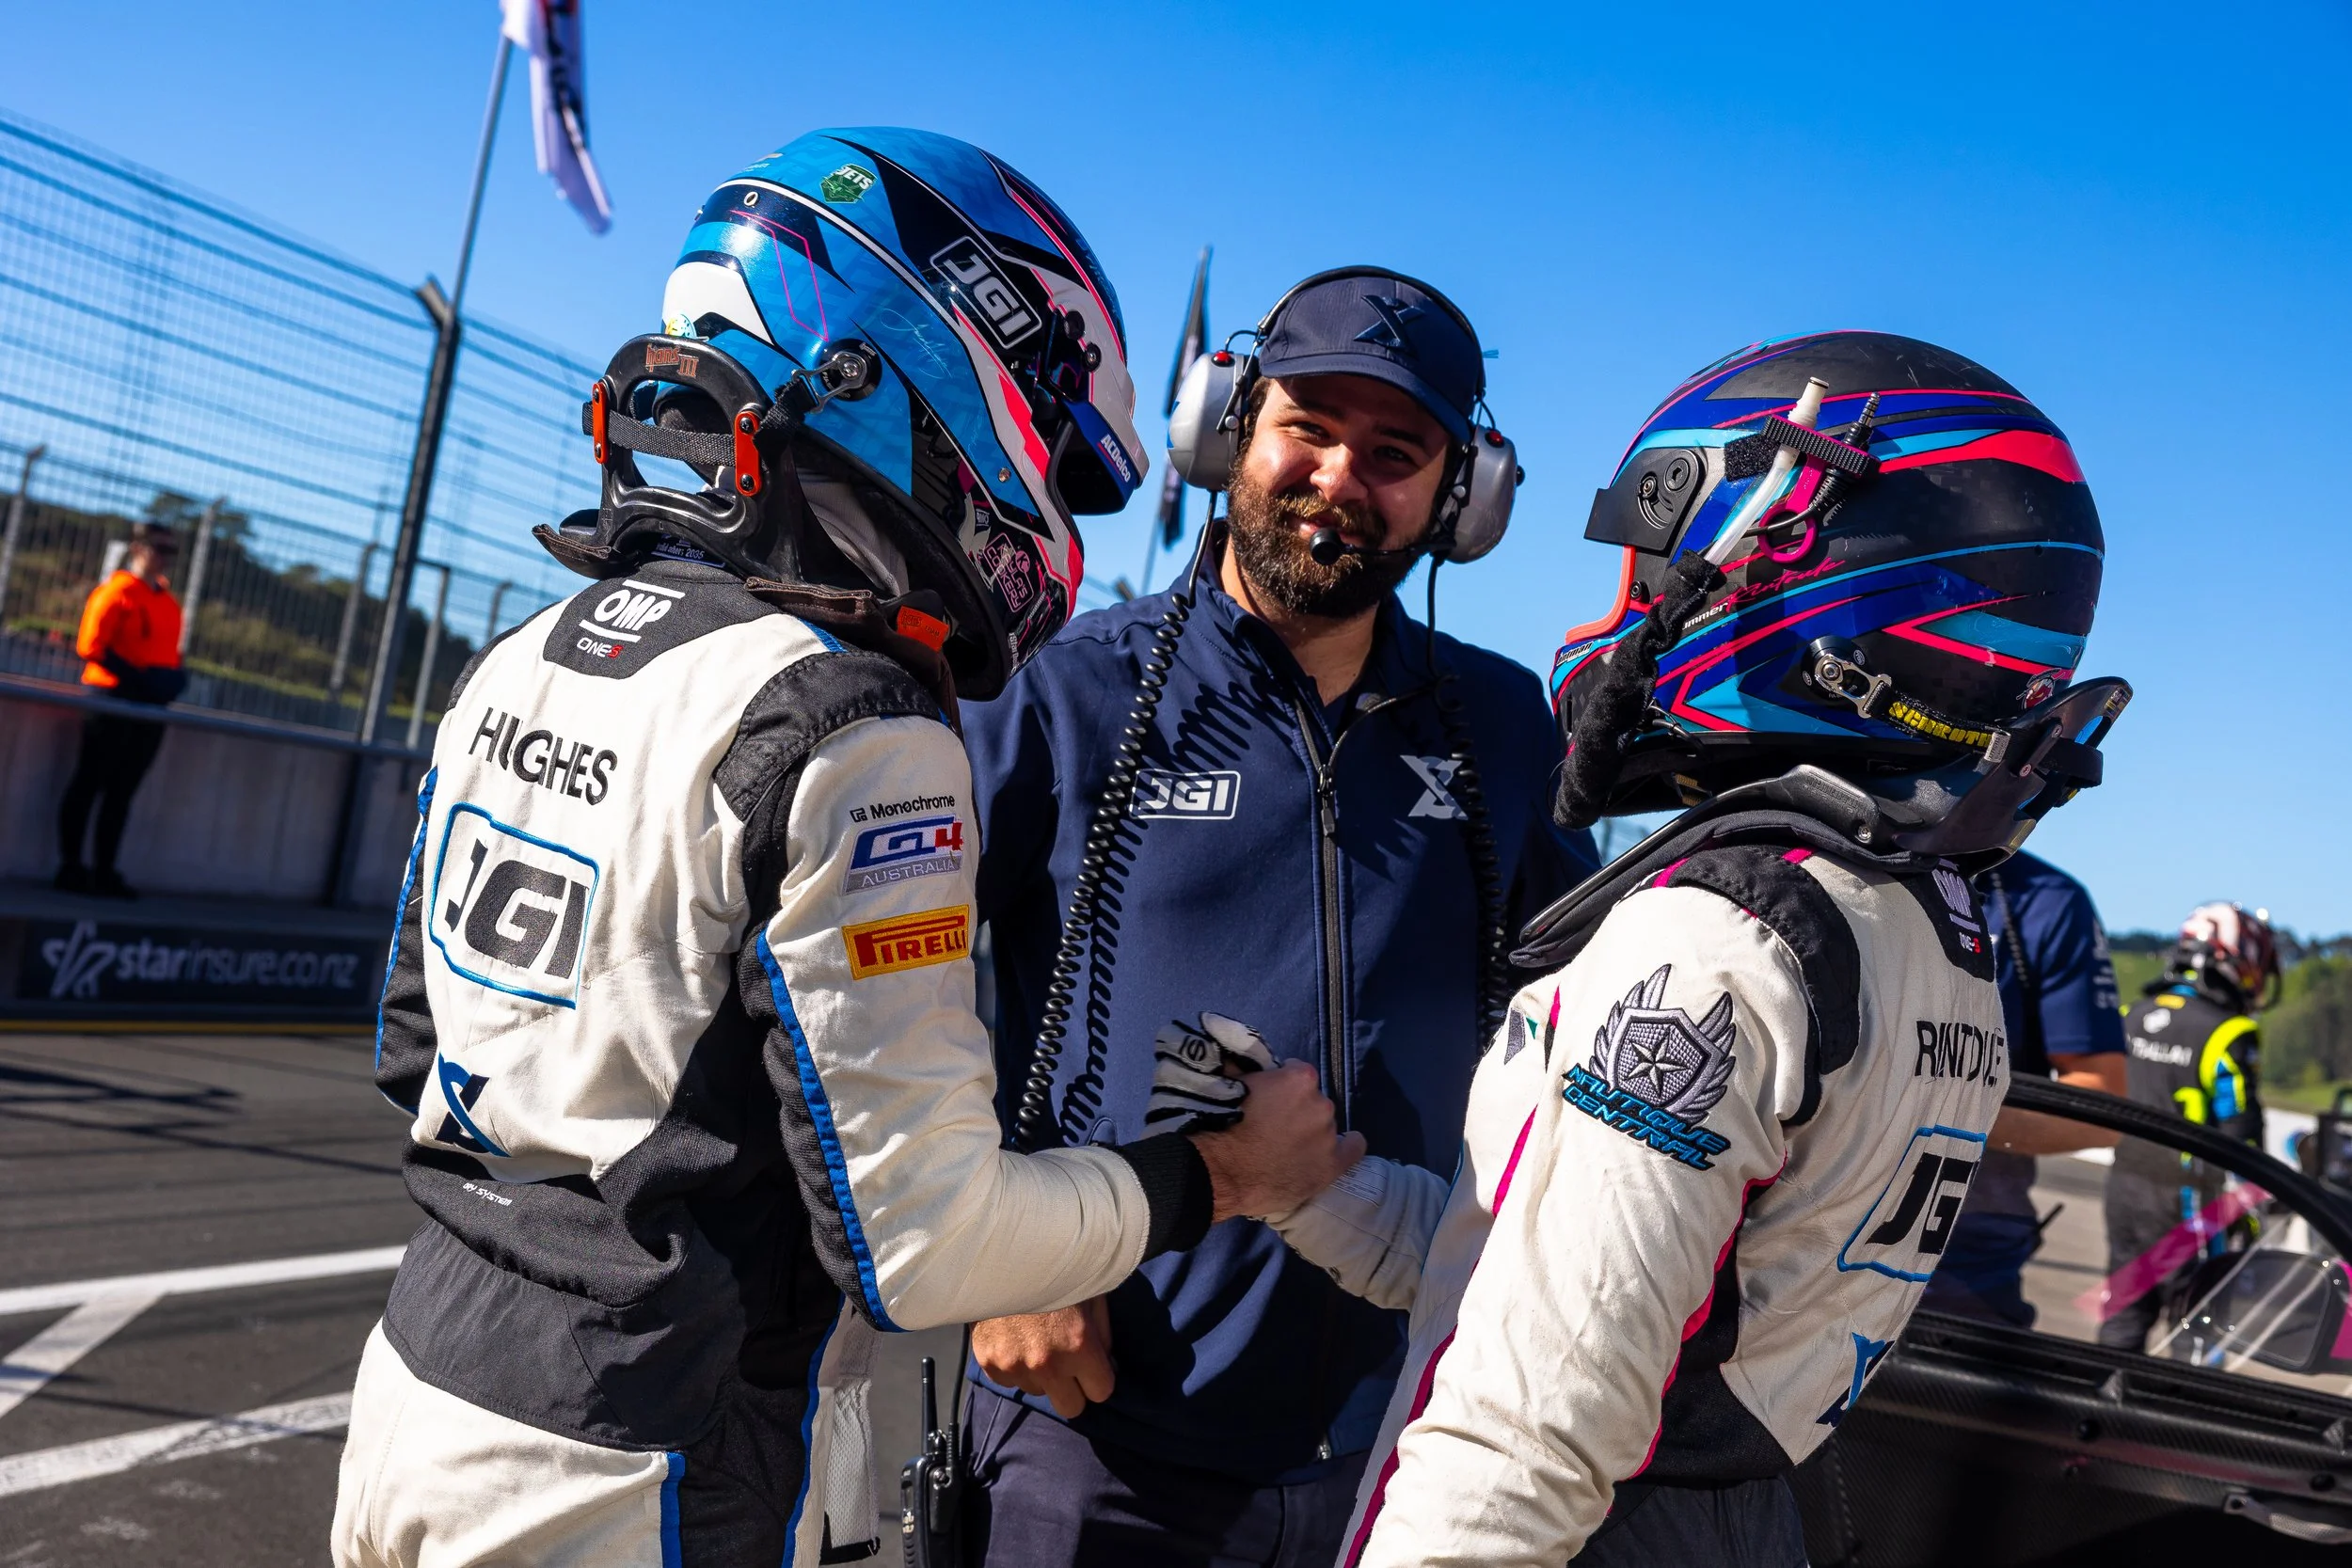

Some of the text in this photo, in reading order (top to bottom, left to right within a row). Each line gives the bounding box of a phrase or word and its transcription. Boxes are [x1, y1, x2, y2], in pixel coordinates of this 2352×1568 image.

[835, 166, 873, 190] JETS
[943, 253, 1032, 337] JGI
[1100, 433, 1132, 483] ACDelco
[685, 547, 706, 560] 2035
[986, 546, 1022, 609] COOKERY
[595, 589, 673, 631] OMP
[1682, 601, 1728, 631] ummer
[1888, 702, 1993, 749] SCHROTH
[469, 707, 618, 806] HUGHES
[869, 795, 956, 820] Monochrome
[1139, 777, 1231, 811] JGI
[861, 856, 957, 888] AUSTRALIA
[444, 838, 590, 980] JGI
[853, 914, 967, 968] PIRELLI
[1565, 1085, 1707, 1169] CENTRAL
[1568, 1065, 1727, 1153] NAUTIQUE
[475, 1187, 513, 1207] SYSTEM
[1865, 1152, 1980, 1256] JG
